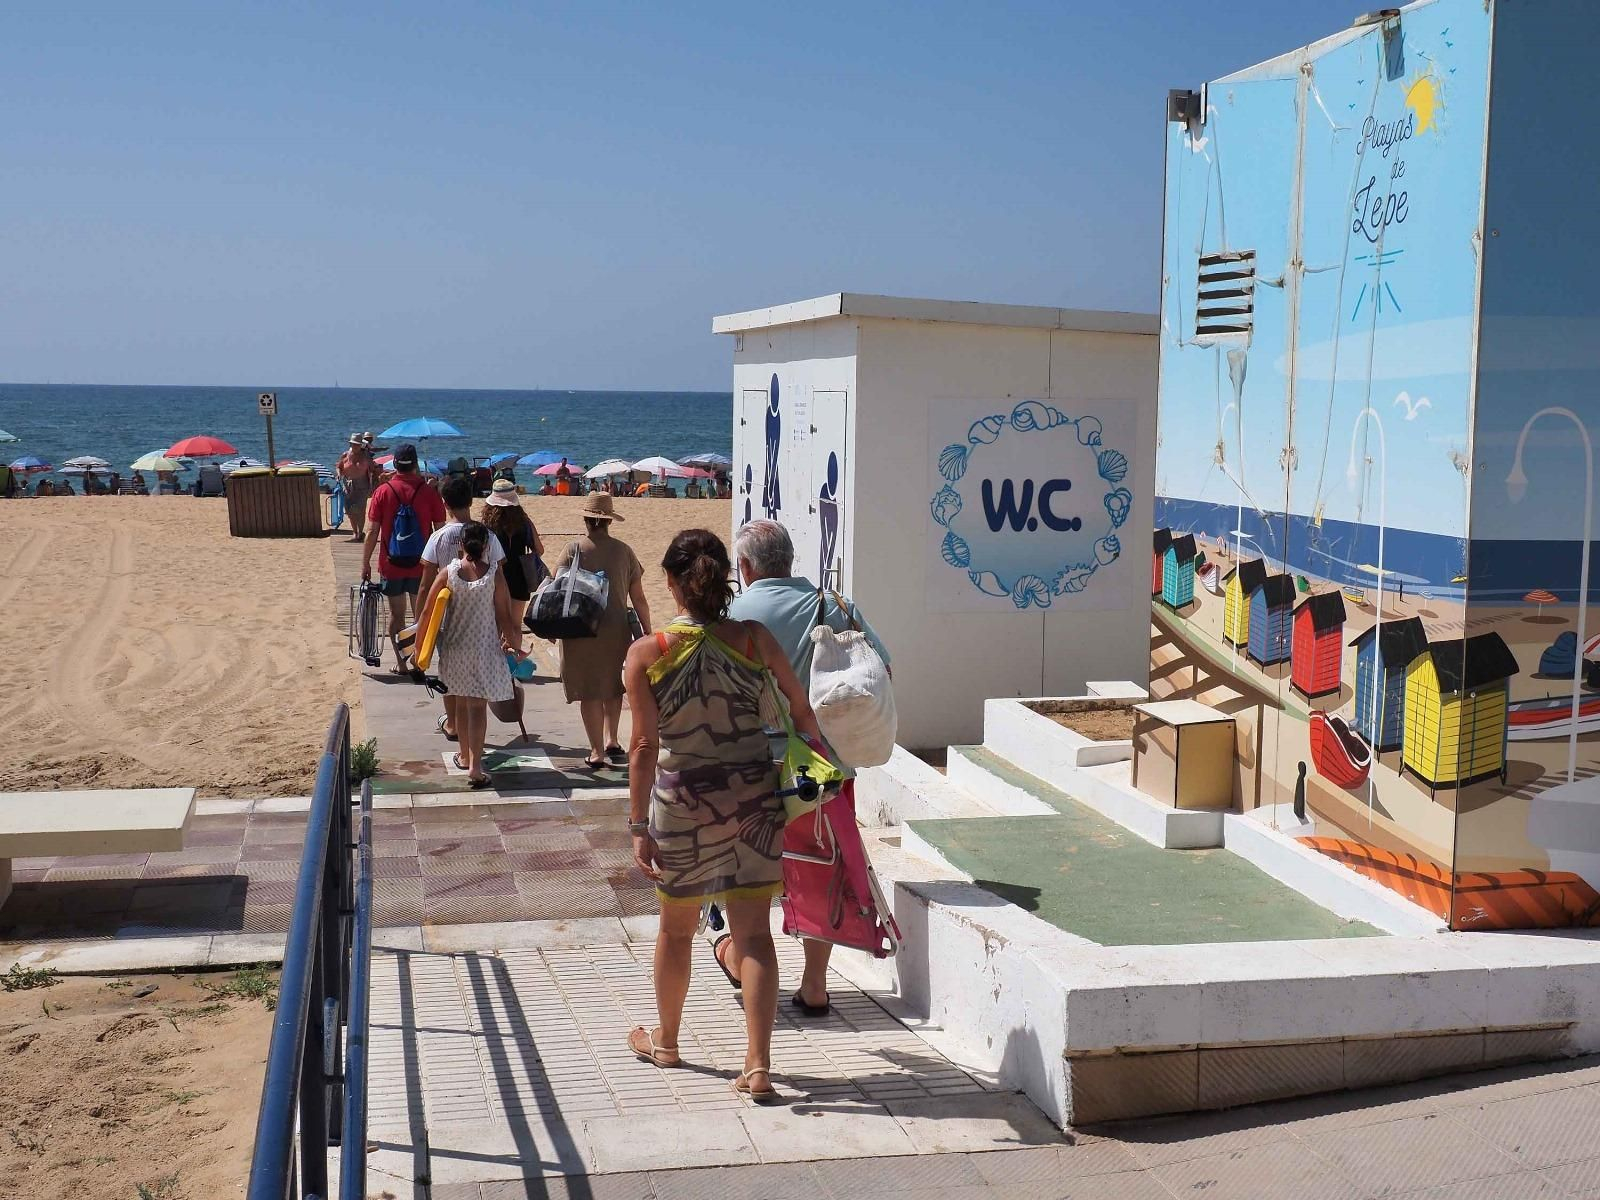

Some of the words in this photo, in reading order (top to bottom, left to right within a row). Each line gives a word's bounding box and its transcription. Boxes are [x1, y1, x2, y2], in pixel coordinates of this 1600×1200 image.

[1356, 113, 1413, 158] Playas
[1391, 157, 1406, 180] de
[1352, 175, 1409, 243] Lepe
[981, 478, 1082, 532] W.C.
